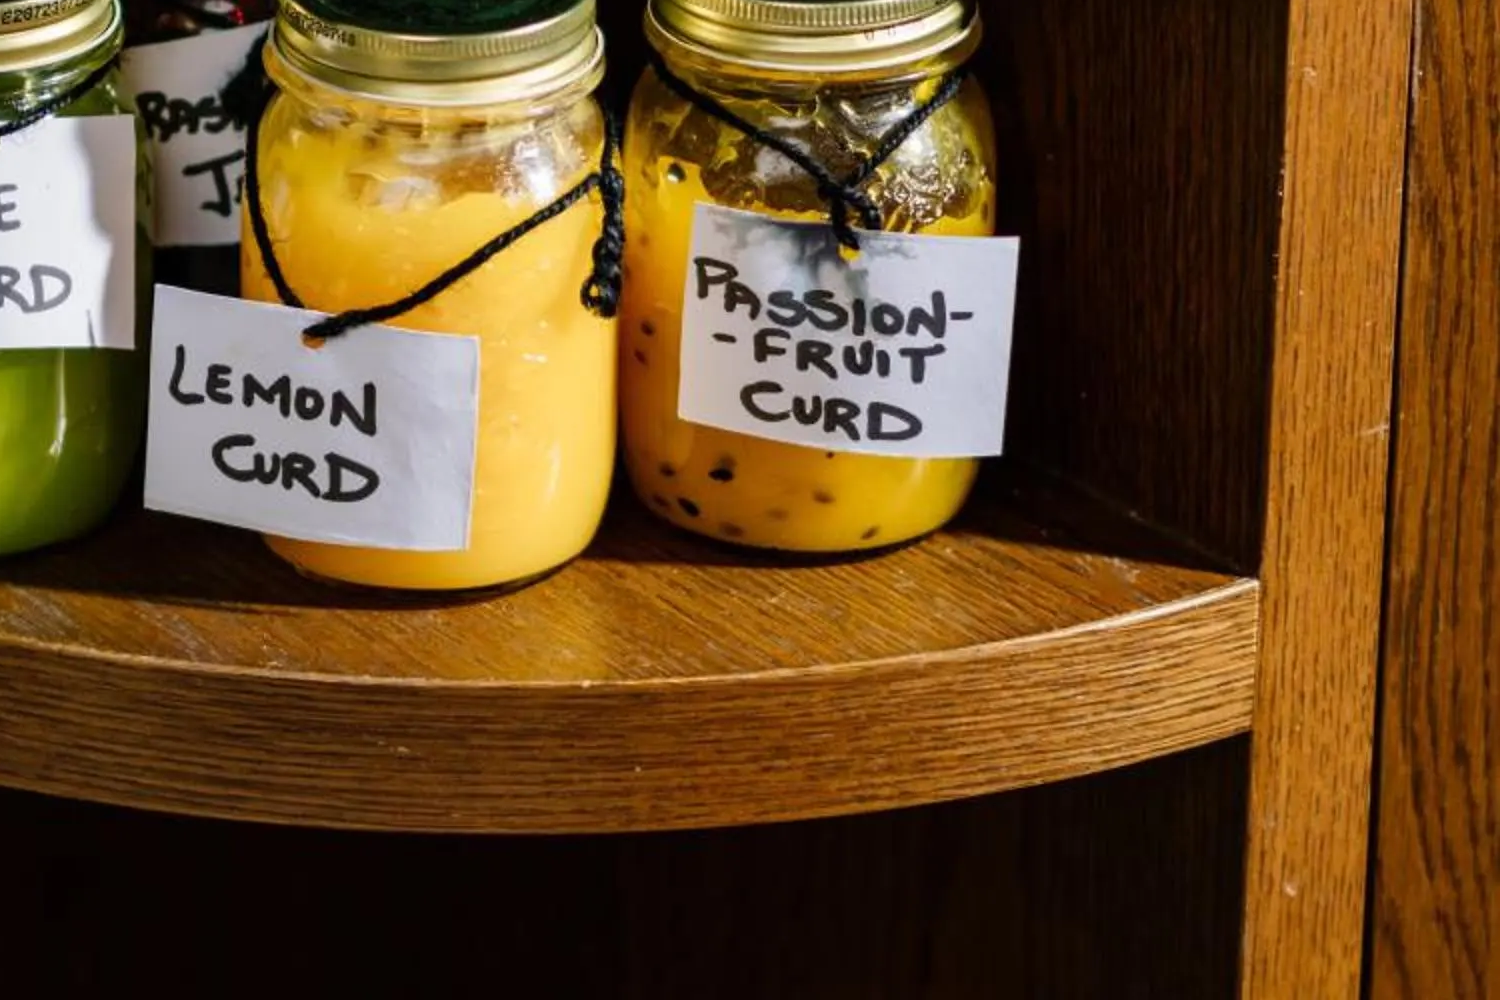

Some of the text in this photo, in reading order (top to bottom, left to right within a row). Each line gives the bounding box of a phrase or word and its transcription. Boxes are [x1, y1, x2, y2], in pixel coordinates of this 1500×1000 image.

[182, 149, 247, 217] J
[693, 255, 975, 340] PASSION-
[168, 343, 378, 438] LEMON
[712, 326, 948, 386] -FRUIT
[739, 380, 924, 442] CURD
[211, 433, 381, 503] CURD
